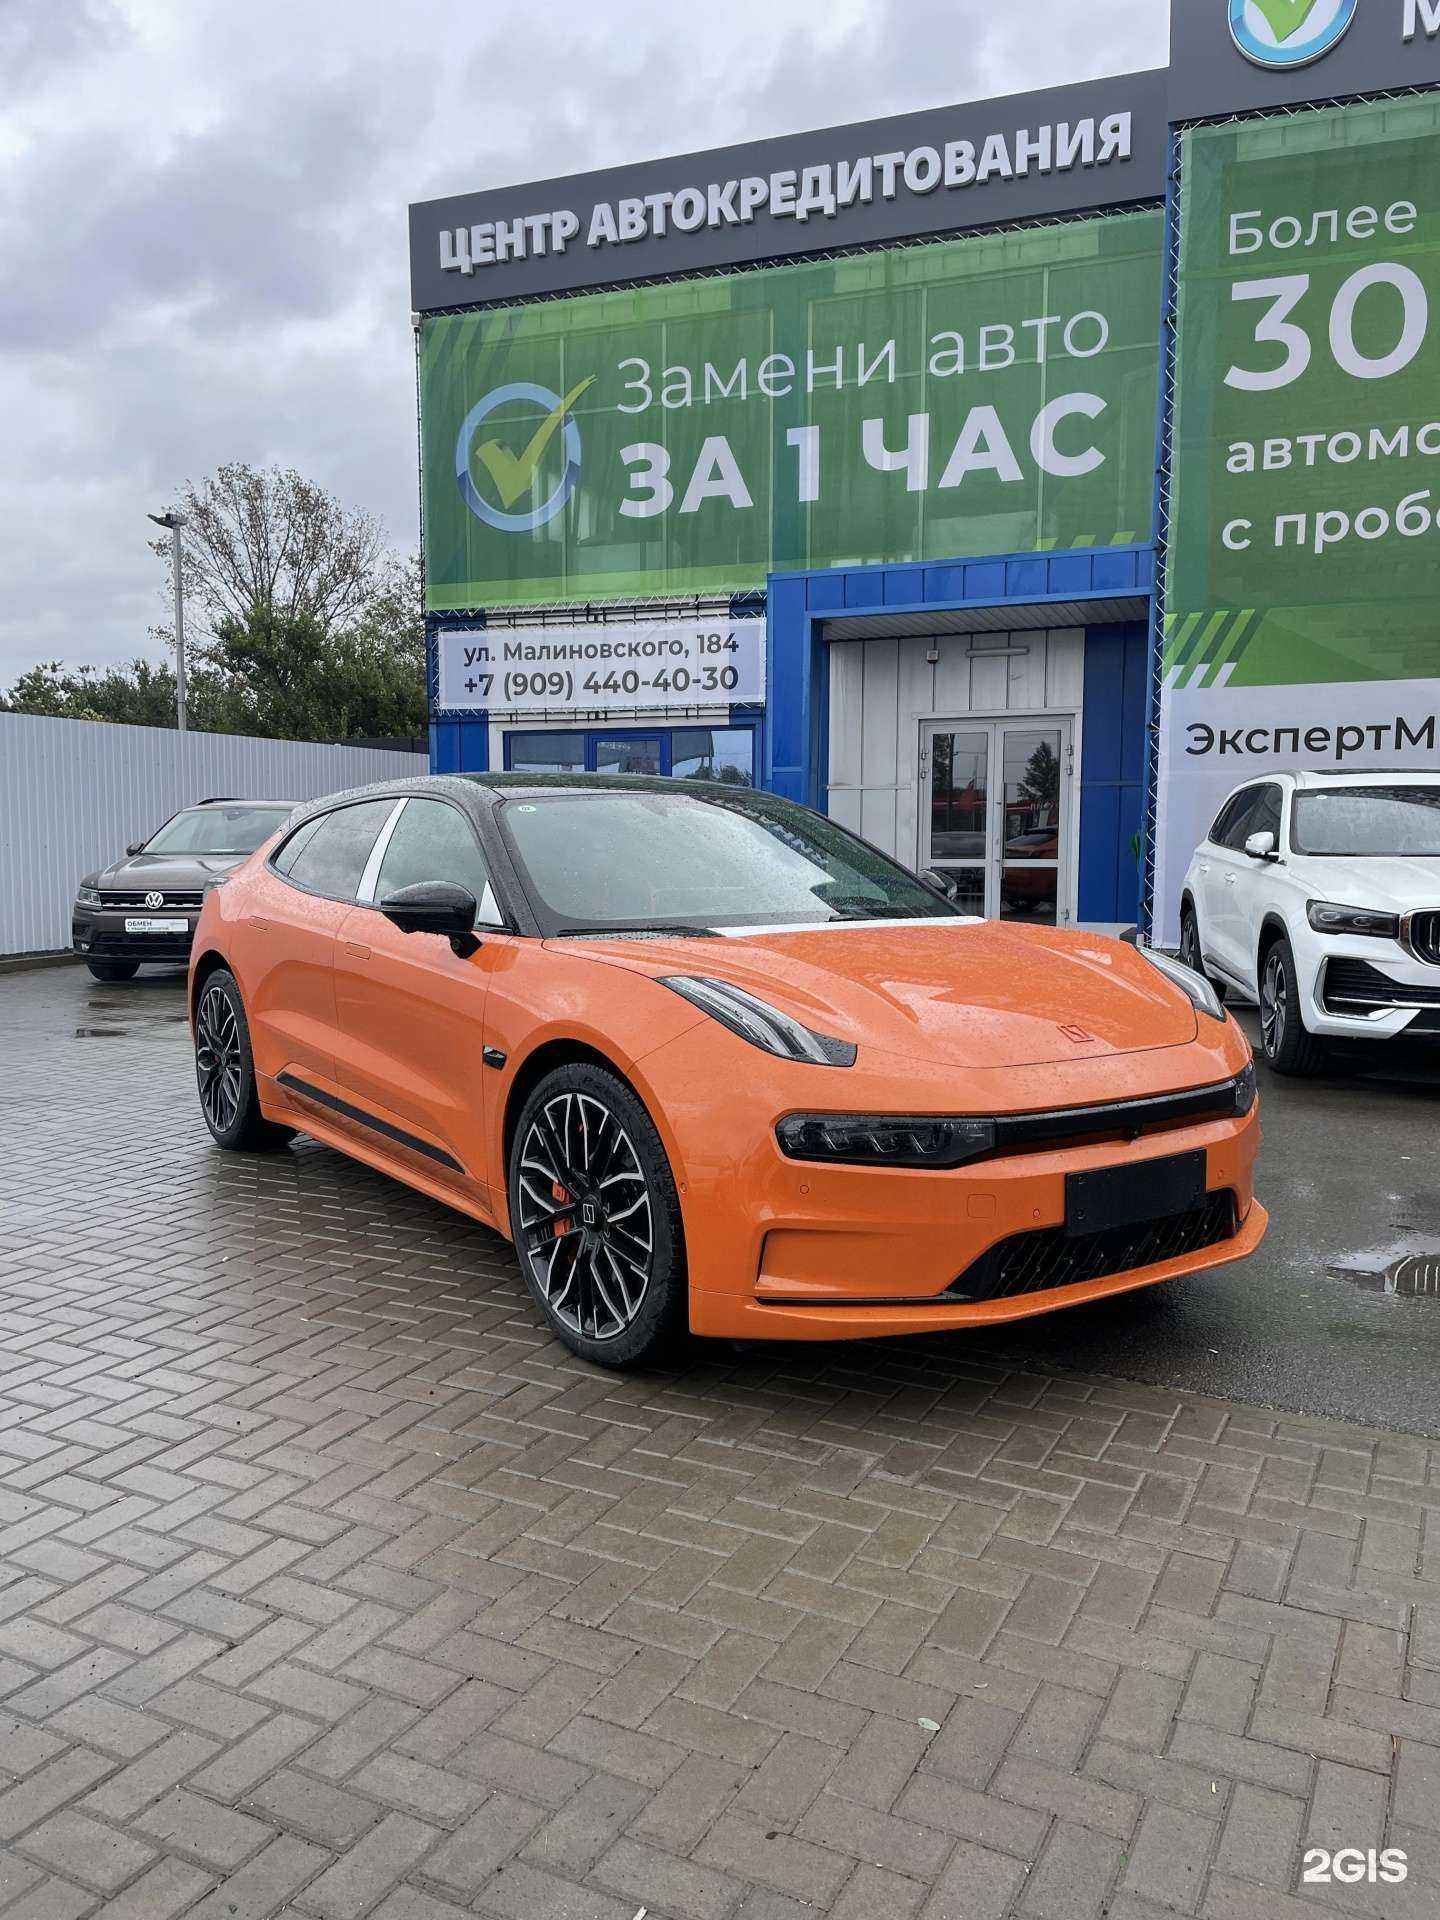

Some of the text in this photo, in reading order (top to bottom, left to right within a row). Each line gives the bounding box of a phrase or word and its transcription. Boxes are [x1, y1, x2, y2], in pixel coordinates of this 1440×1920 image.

[439, 112, 1132, 276] ЦЕНТР АВТОКРЕДИТОВАНИЯ
[1229, 200, 1418, 255] Более
[1223, 262, 1428, 391] 30
[617, 310, 1109, 413] Замени авто
[618, 392, 1108, 518] ЗА 1 ЧАС
[1222, 489, 1440, 554] с проб
[464, 632, 739, 667] ул. Малиновского, 184
[464, 665, 739, 701] +7 (909) 440-40-30
[1185, 716, 1435, 761] ЭкспертМ
